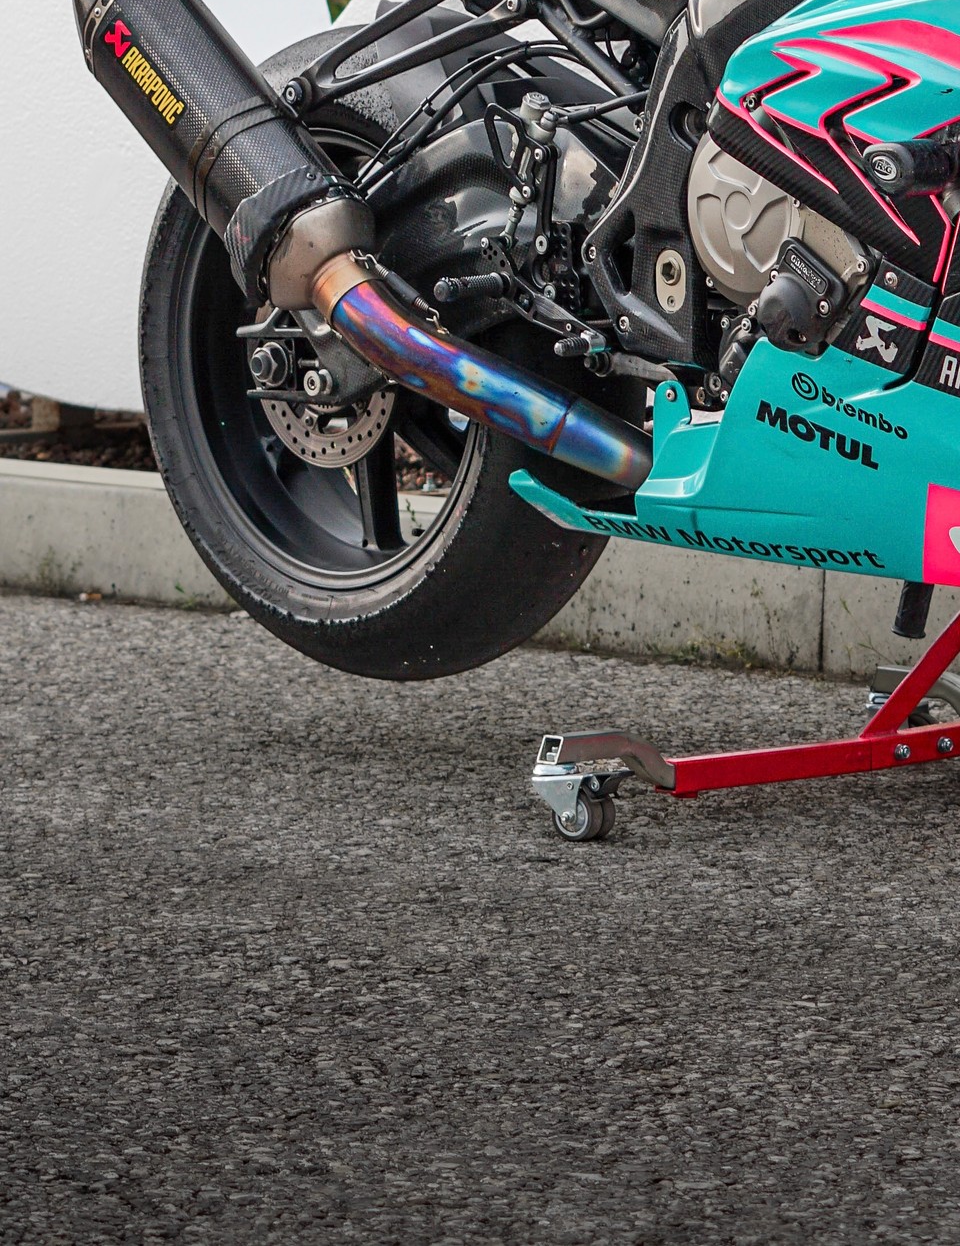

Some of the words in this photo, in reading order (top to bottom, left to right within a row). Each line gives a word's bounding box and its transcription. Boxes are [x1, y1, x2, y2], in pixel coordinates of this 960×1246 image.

[756, 400, 880, 471] MOTUL
[821, 386, 908, 440] brembo
[582, 514, 672, 542] BMW
[676, 528, 886, 570] Motorsport
